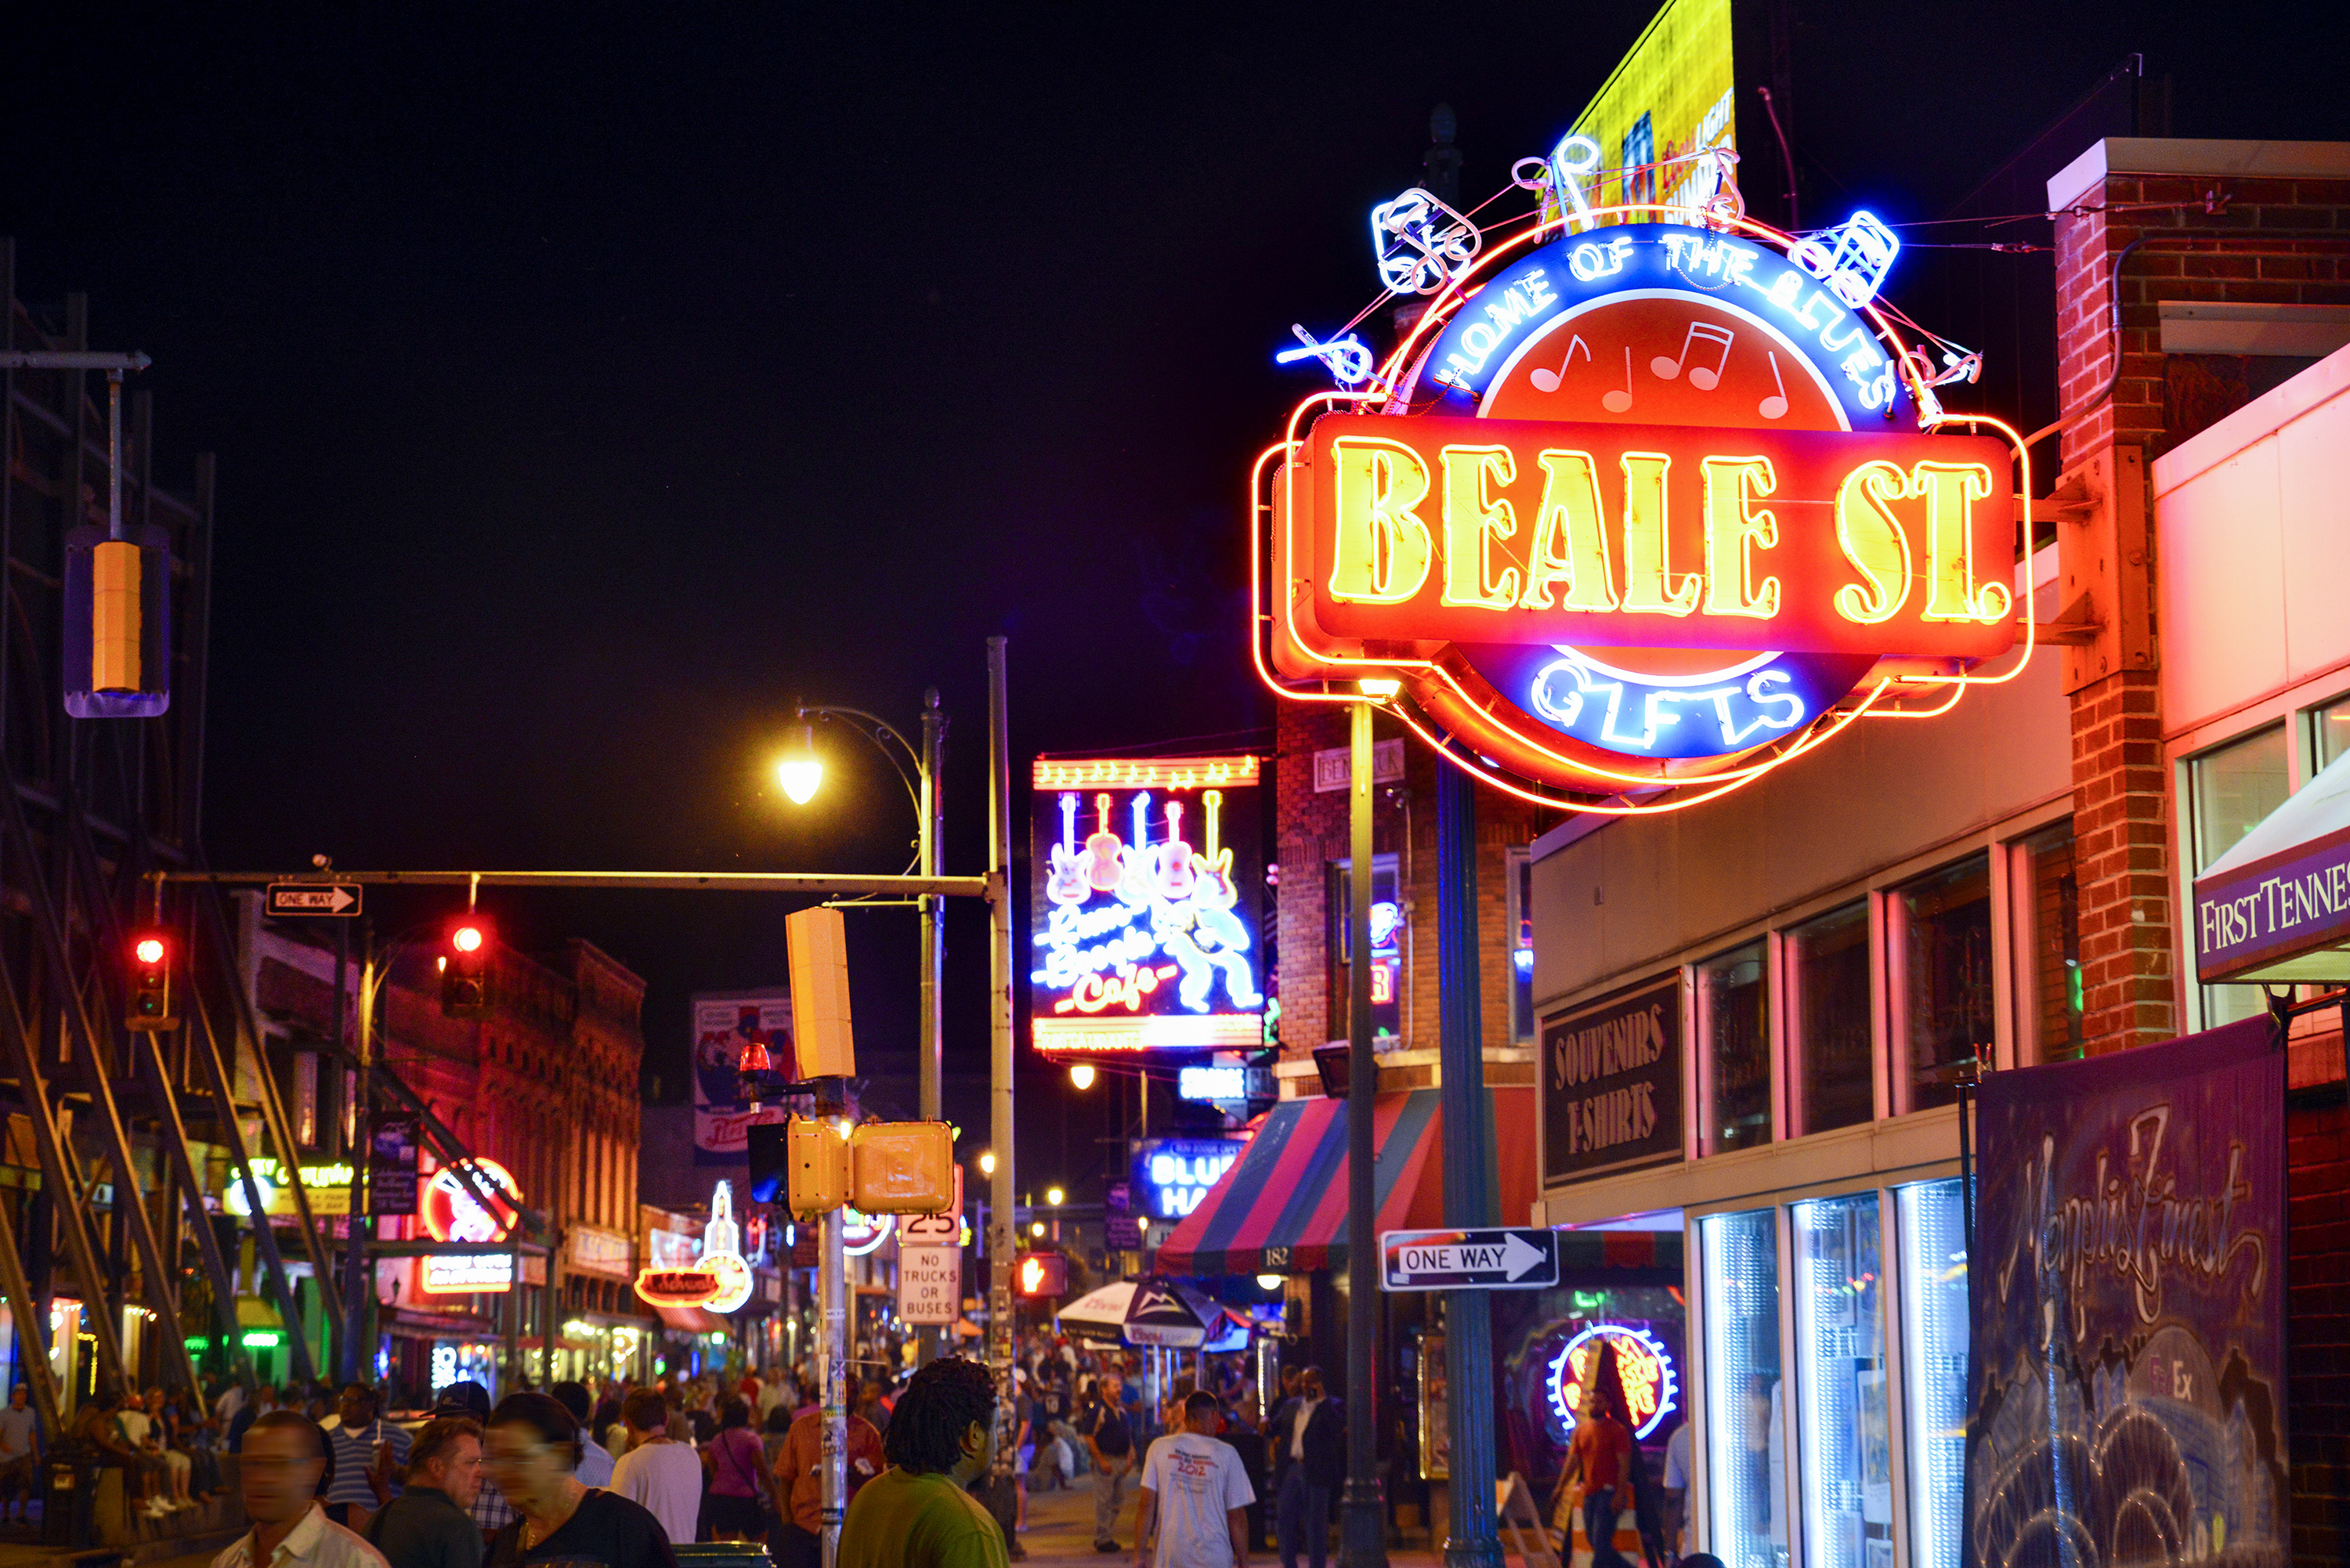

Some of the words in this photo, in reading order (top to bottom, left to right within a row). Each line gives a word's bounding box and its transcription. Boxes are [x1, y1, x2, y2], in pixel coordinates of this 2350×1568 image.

[1694, 86, 1734, 156] LIGHT
[1433, 268, 1559, 392] HOME
[1566, 236, 1635, 282] OF
[1658, 233, 1760, 280] THE
[1765, 269, 1897, 410] BLUES
[1329, 436, 1780, 619] BEALE
[1833, 460, 2012, 625] ST.
[1530, 657, 1806, 750] GIFTS
[308, 892, 334, 905] WAY
[1554, 1003, 1667, 1091] SOUVENIRS
[1567, 1080, 1659, 1155] T-SHIRTS
[920, 1255, 940, 1266] NO
[1265, 1247, 1289, 1267] 182
[1405, 1248, 1452, 1270] ONE
[1459, 1246, 1507, 1269] WAY
[904, 1270, 957, 1283] TRUCKS
[920, 1287, 938, 1299] OR
[906, 1302, 953, 1315] BUSES
[1177, 1461, 1207, 1477] 2012
